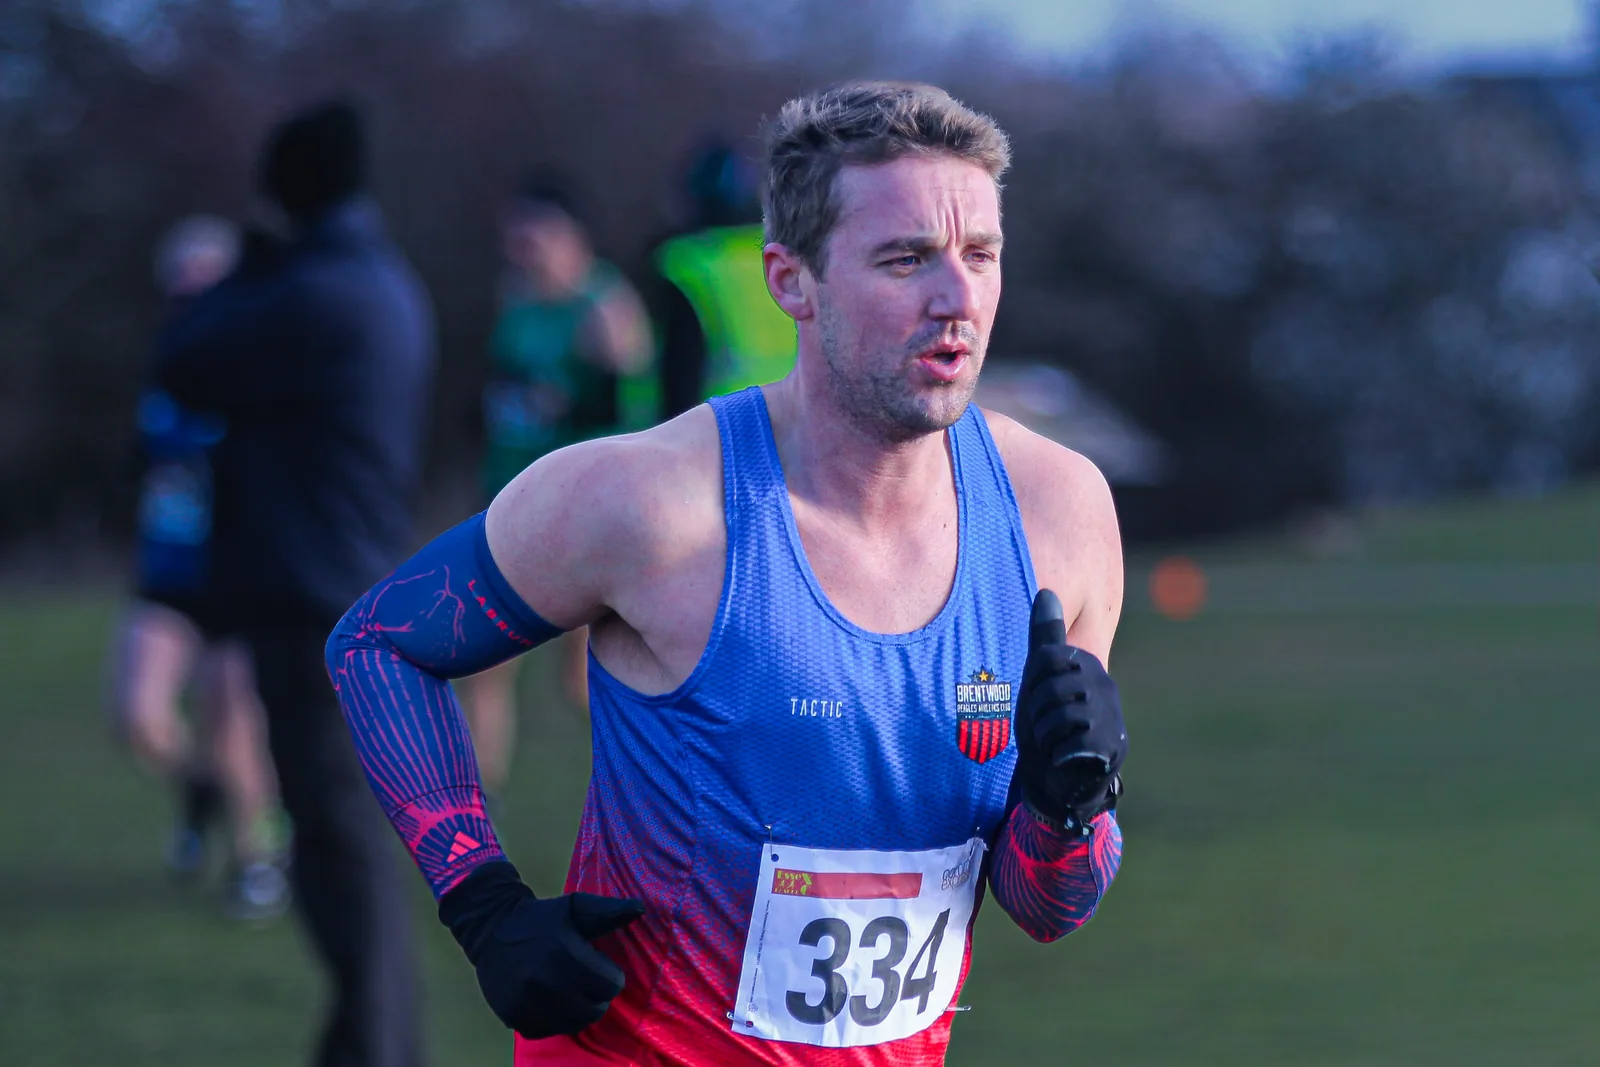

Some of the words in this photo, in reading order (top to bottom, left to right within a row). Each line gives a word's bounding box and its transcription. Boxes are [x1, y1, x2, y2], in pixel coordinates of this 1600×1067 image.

[957, 684, 1011, 702] BRENTWOOD
[790, 698, 843, 718] TACTIC
[785, 908, 951, 1027] 334
